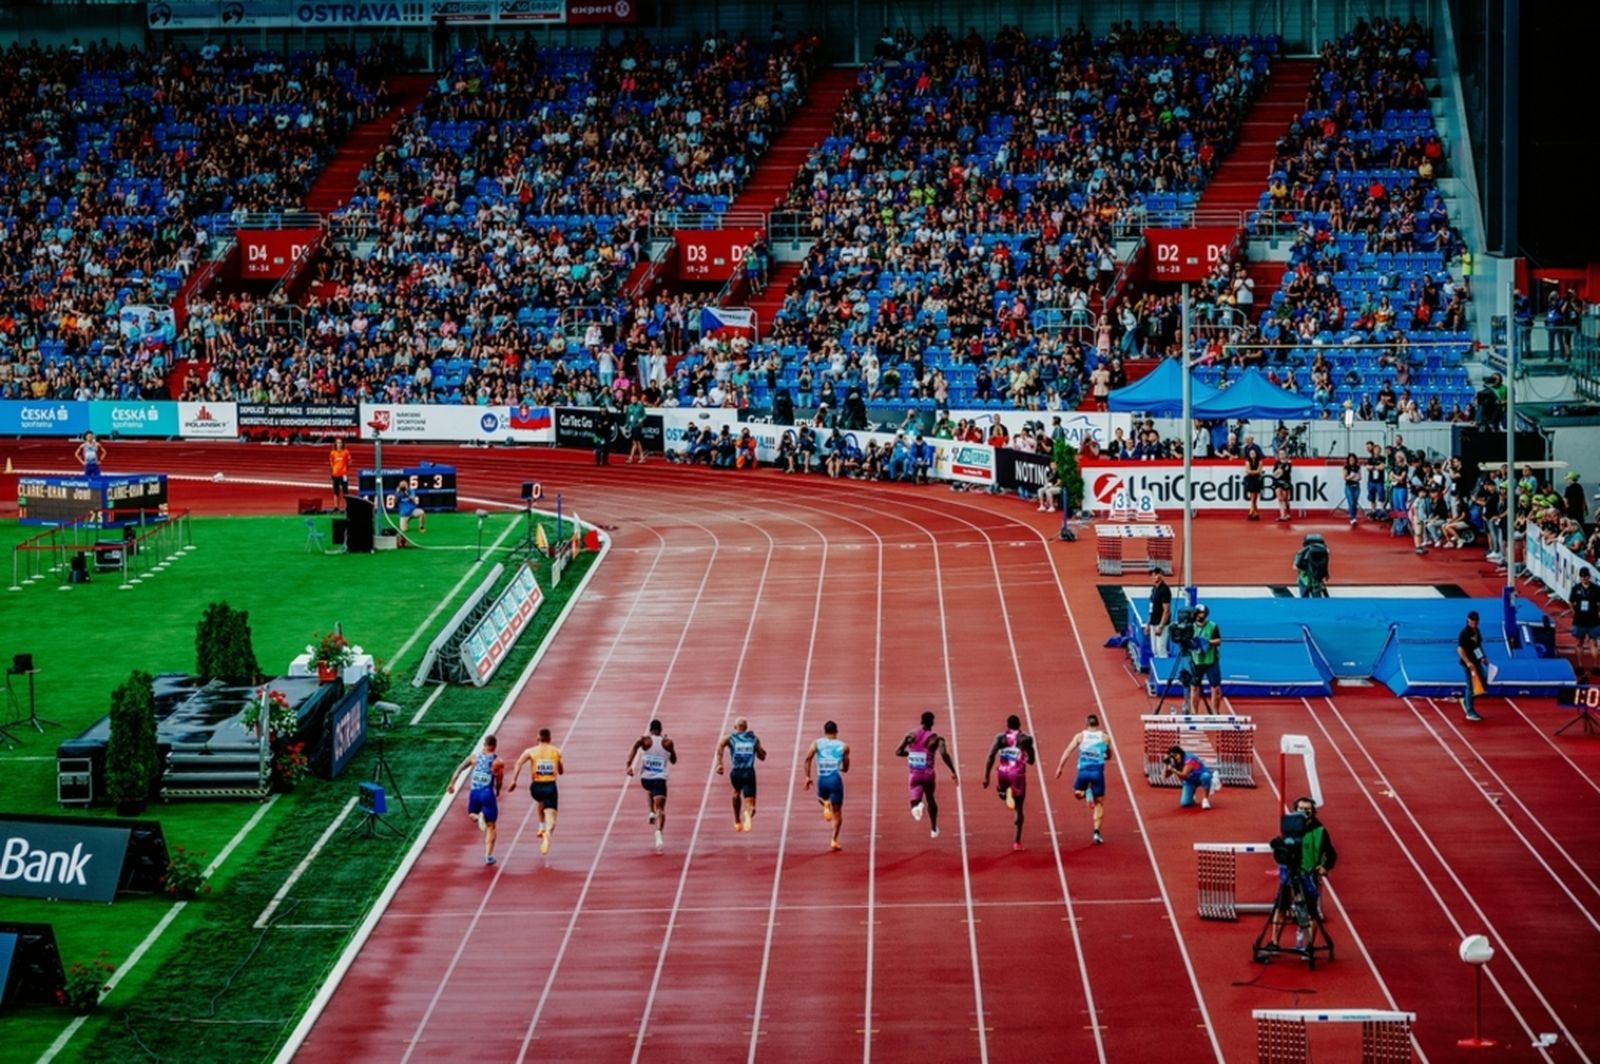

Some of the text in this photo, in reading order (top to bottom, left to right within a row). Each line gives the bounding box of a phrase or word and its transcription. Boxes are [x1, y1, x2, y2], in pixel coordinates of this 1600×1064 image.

[297, 3, 424, 23] OSTRAVA!!!
[570, 5, 612, 15] expert
[248, 244, 268, 261] D4
[687, 245, 707, 262] D3
[1158, 244, 1178, 261] D2
[20, 406, 56, 421] ČESKÁ
[111, 406, 147, 421] ČESKÁ
[1259, 474, 1329, 502] Bnk
[1115, 493, 1124, 509] 3
[1140, 495, 1151, 512] 8
[0, 837, 93, 886] Bank
